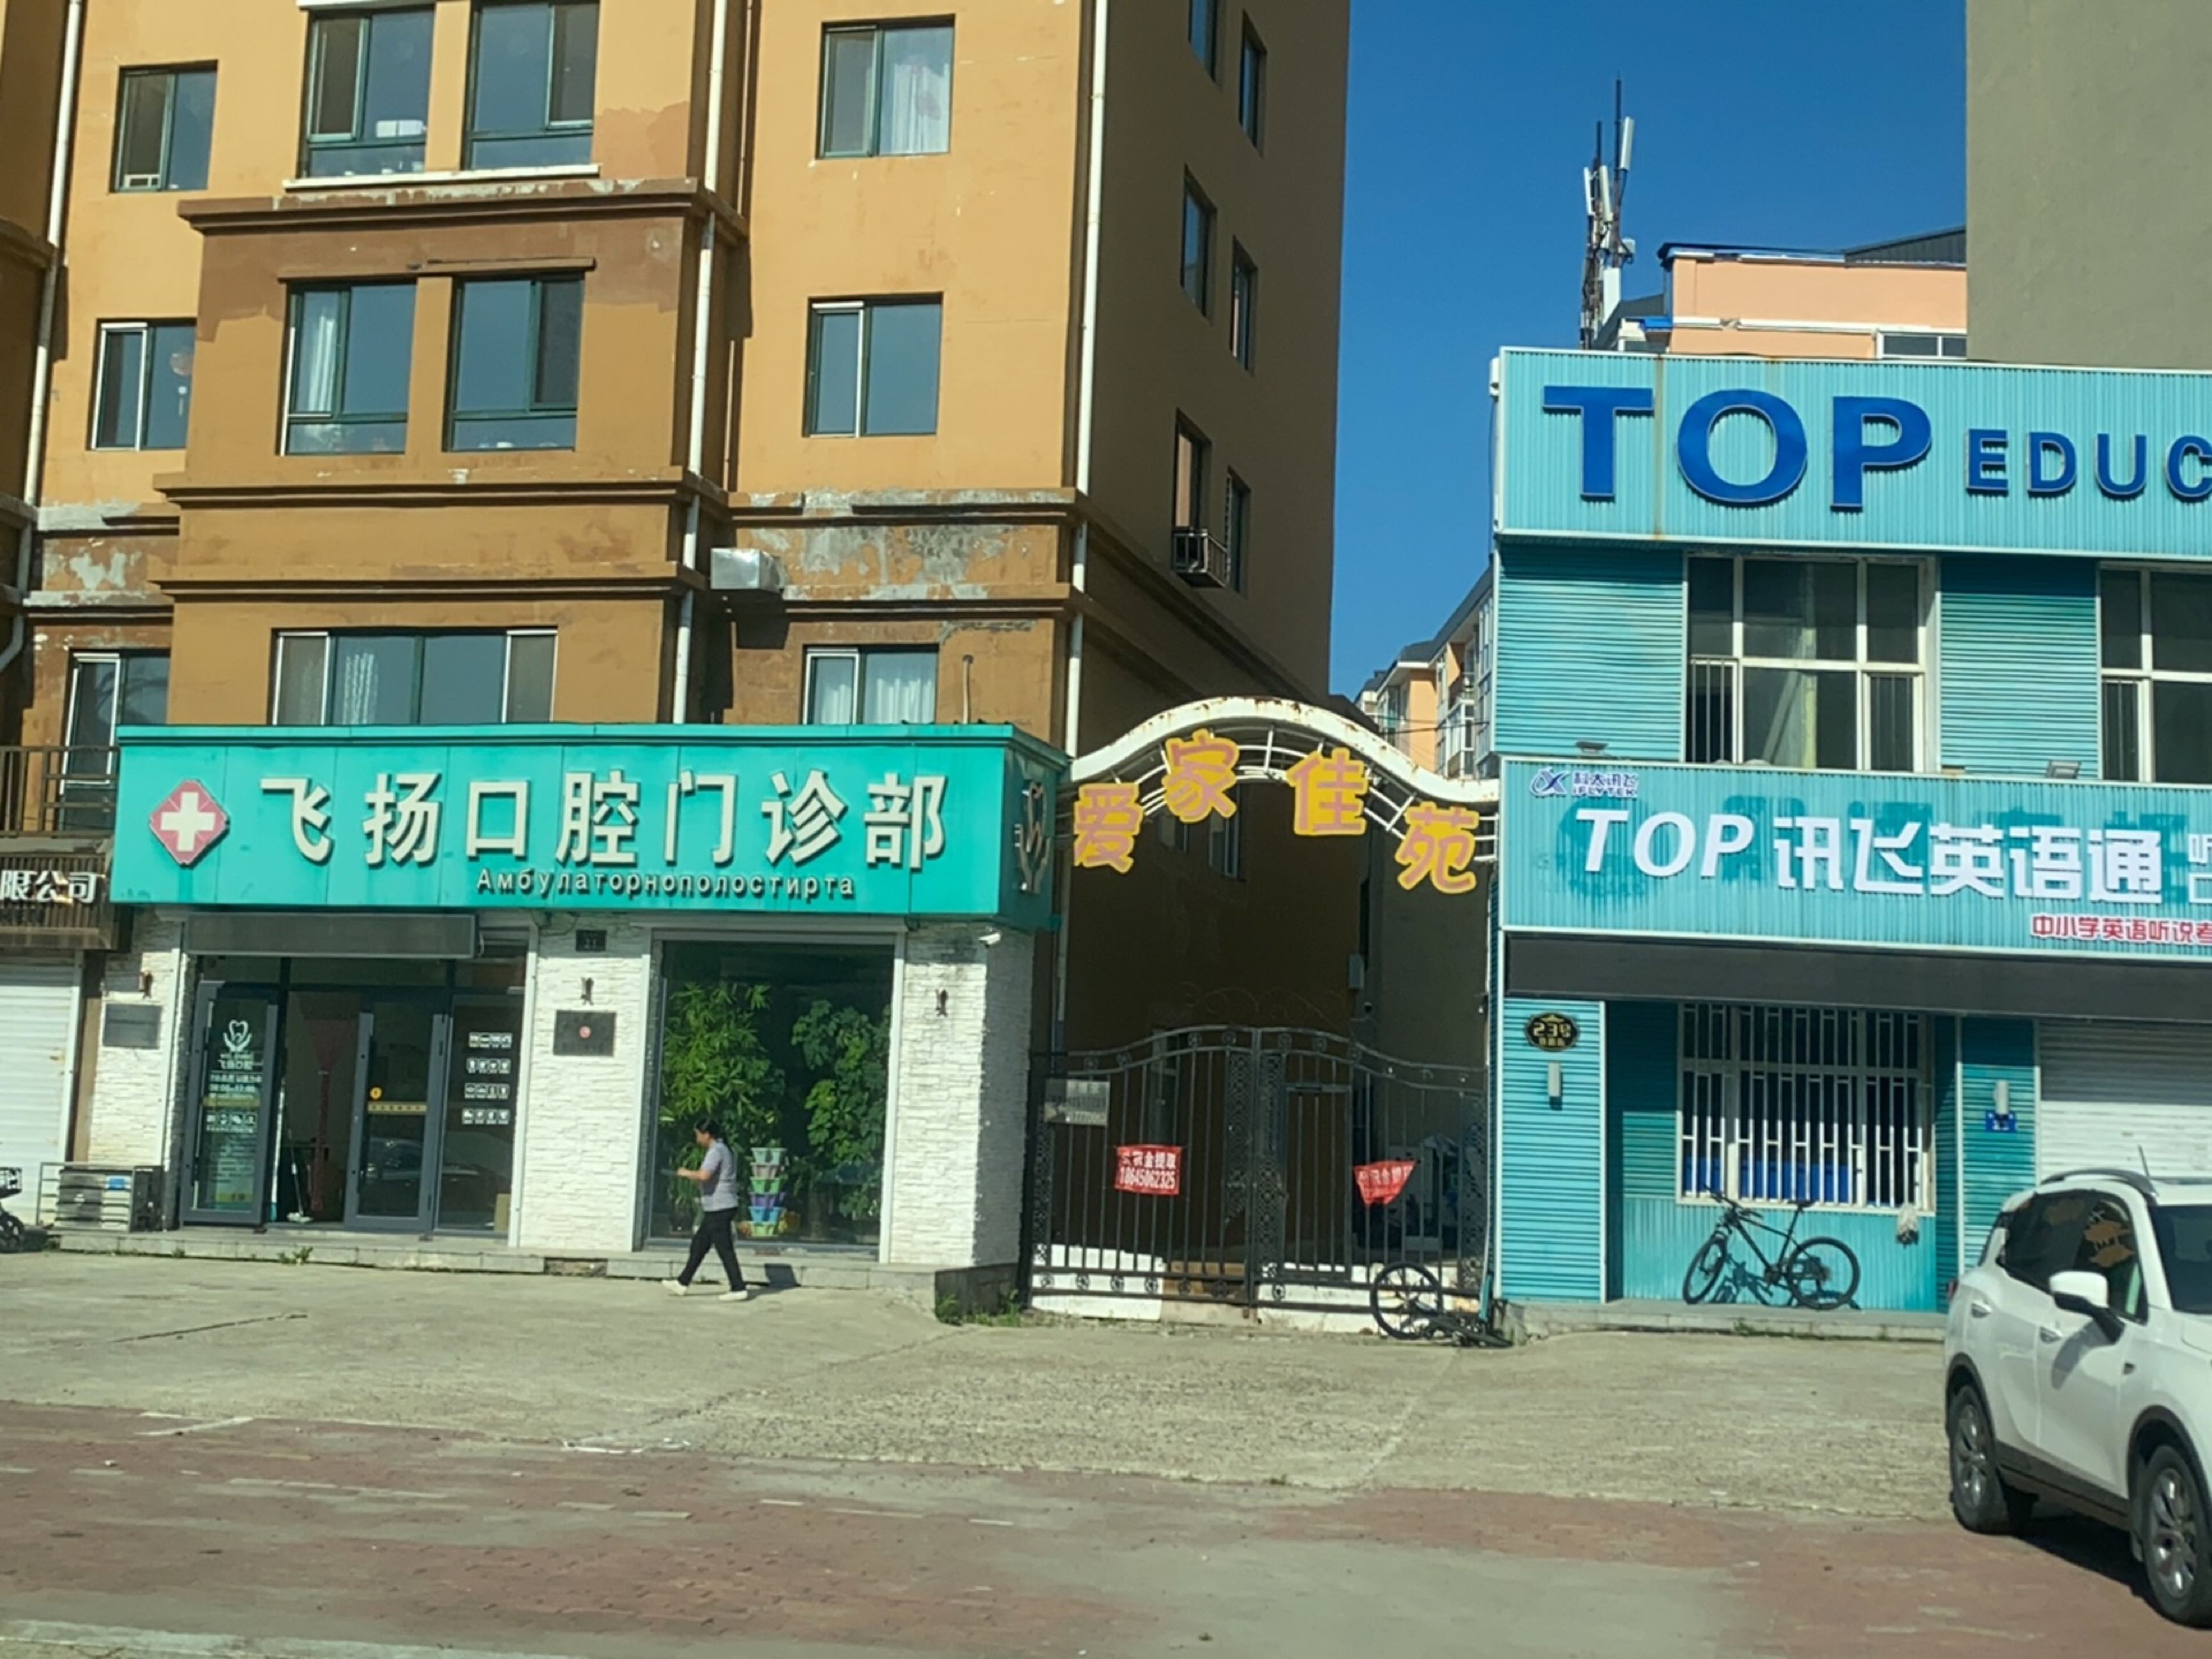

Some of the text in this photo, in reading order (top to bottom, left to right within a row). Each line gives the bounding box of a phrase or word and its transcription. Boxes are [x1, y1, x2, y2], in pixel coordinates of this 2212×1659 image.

[1543, 385, 1933, 509] TOP
[261, 771, 946, 869] 飞扬口腔门诊部
[1073, 729, 1480, 894] 爱家佳苑
[1576, 809, 1754, 878] TOP
[1773, 817, 2162, 904] 讯飞英语通
